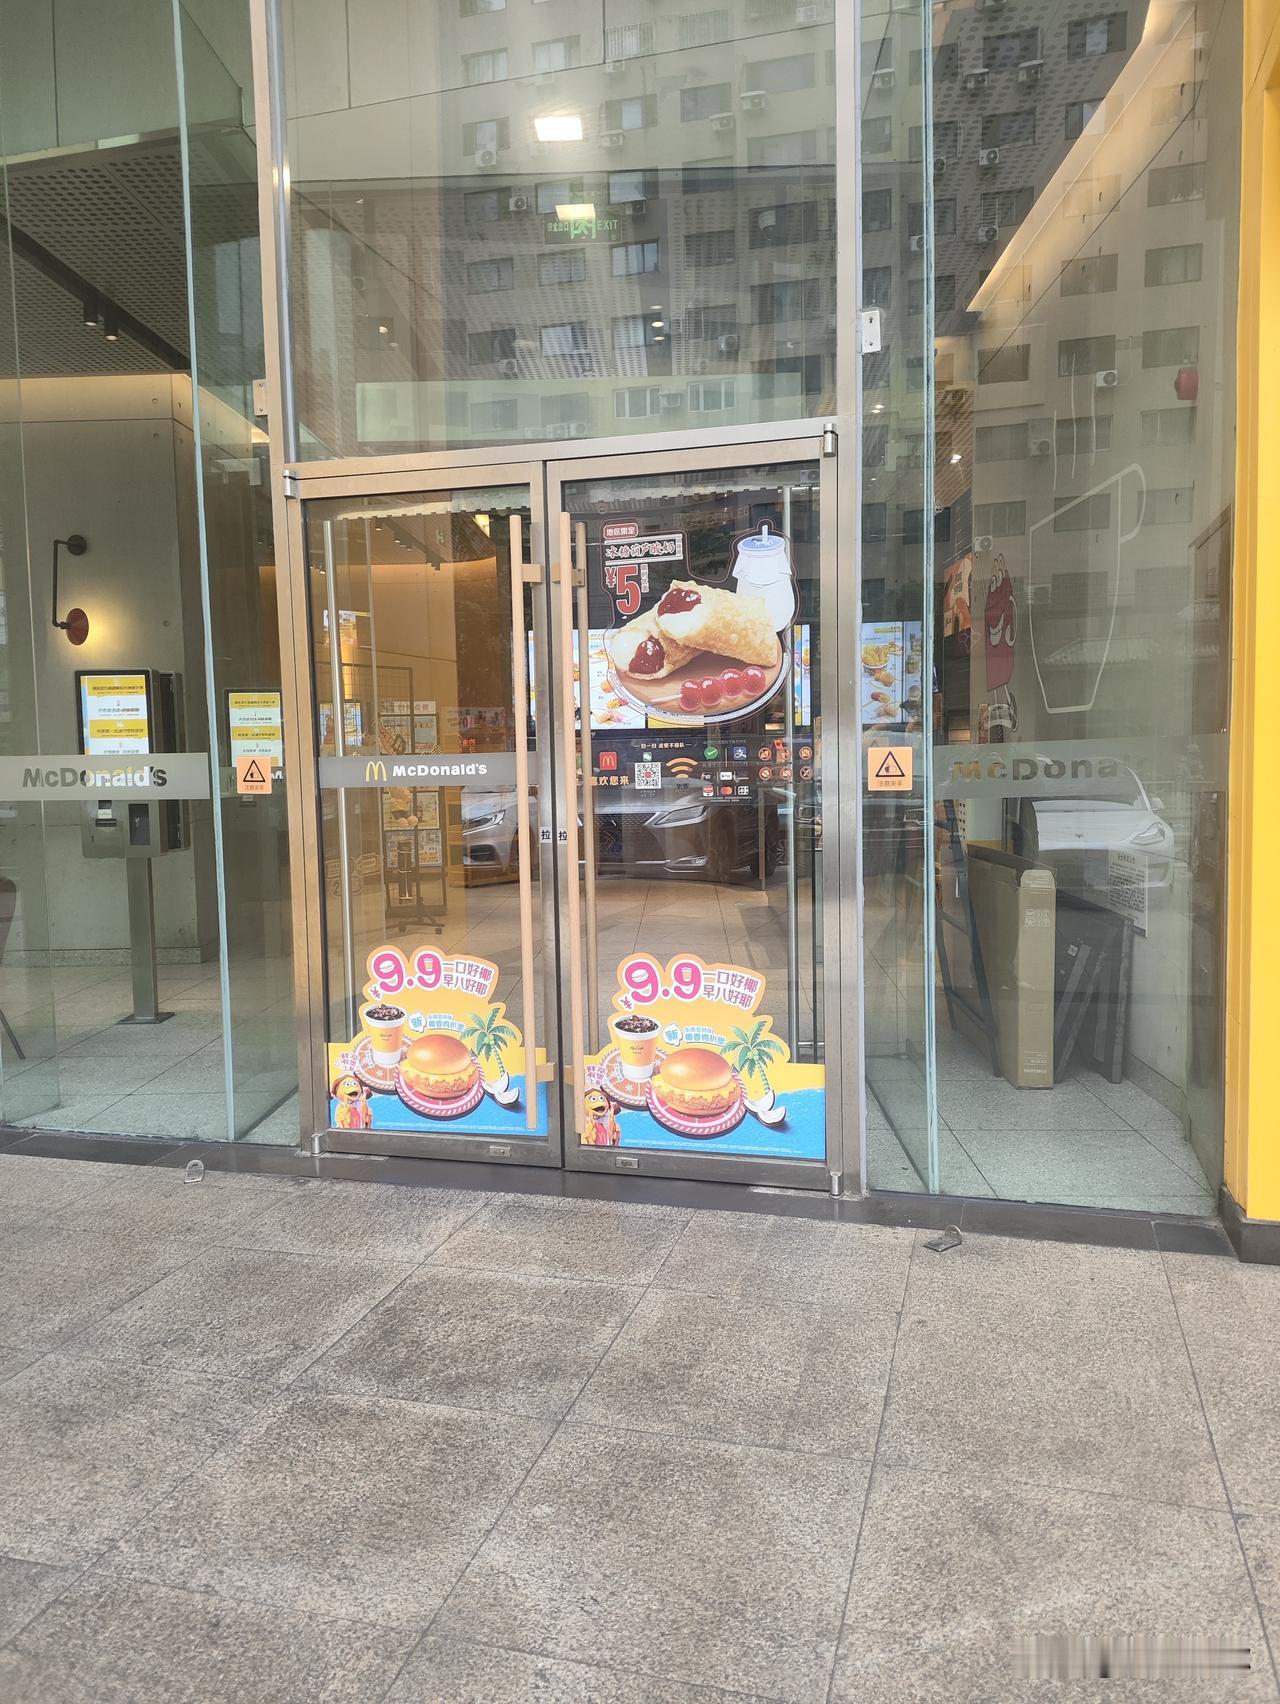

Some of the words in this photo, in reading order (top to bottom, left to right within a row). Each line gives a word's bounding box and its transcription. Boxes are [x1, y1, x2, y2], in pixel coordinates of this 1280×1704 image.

[597, 220, 618, 230] EXIT
[22, 766, 168, 788] McDonald's
[392, 763, 487, 777] McDonald's
[952, 757, 1121, 784] McDona
[541, 830, 551, 840] 拉
[558, 831, 567, 841] 拉
[442, 960, 493, 982] 一口好椰
[443, 973, 488, 996] 早八好耶
[702, 970, 759, 992] 一口好椰
[703, 985, 753, 1009] 早八好耶
[411, 1016, 422, 1029] 新
[665, 1029, 678, 1041] 新
